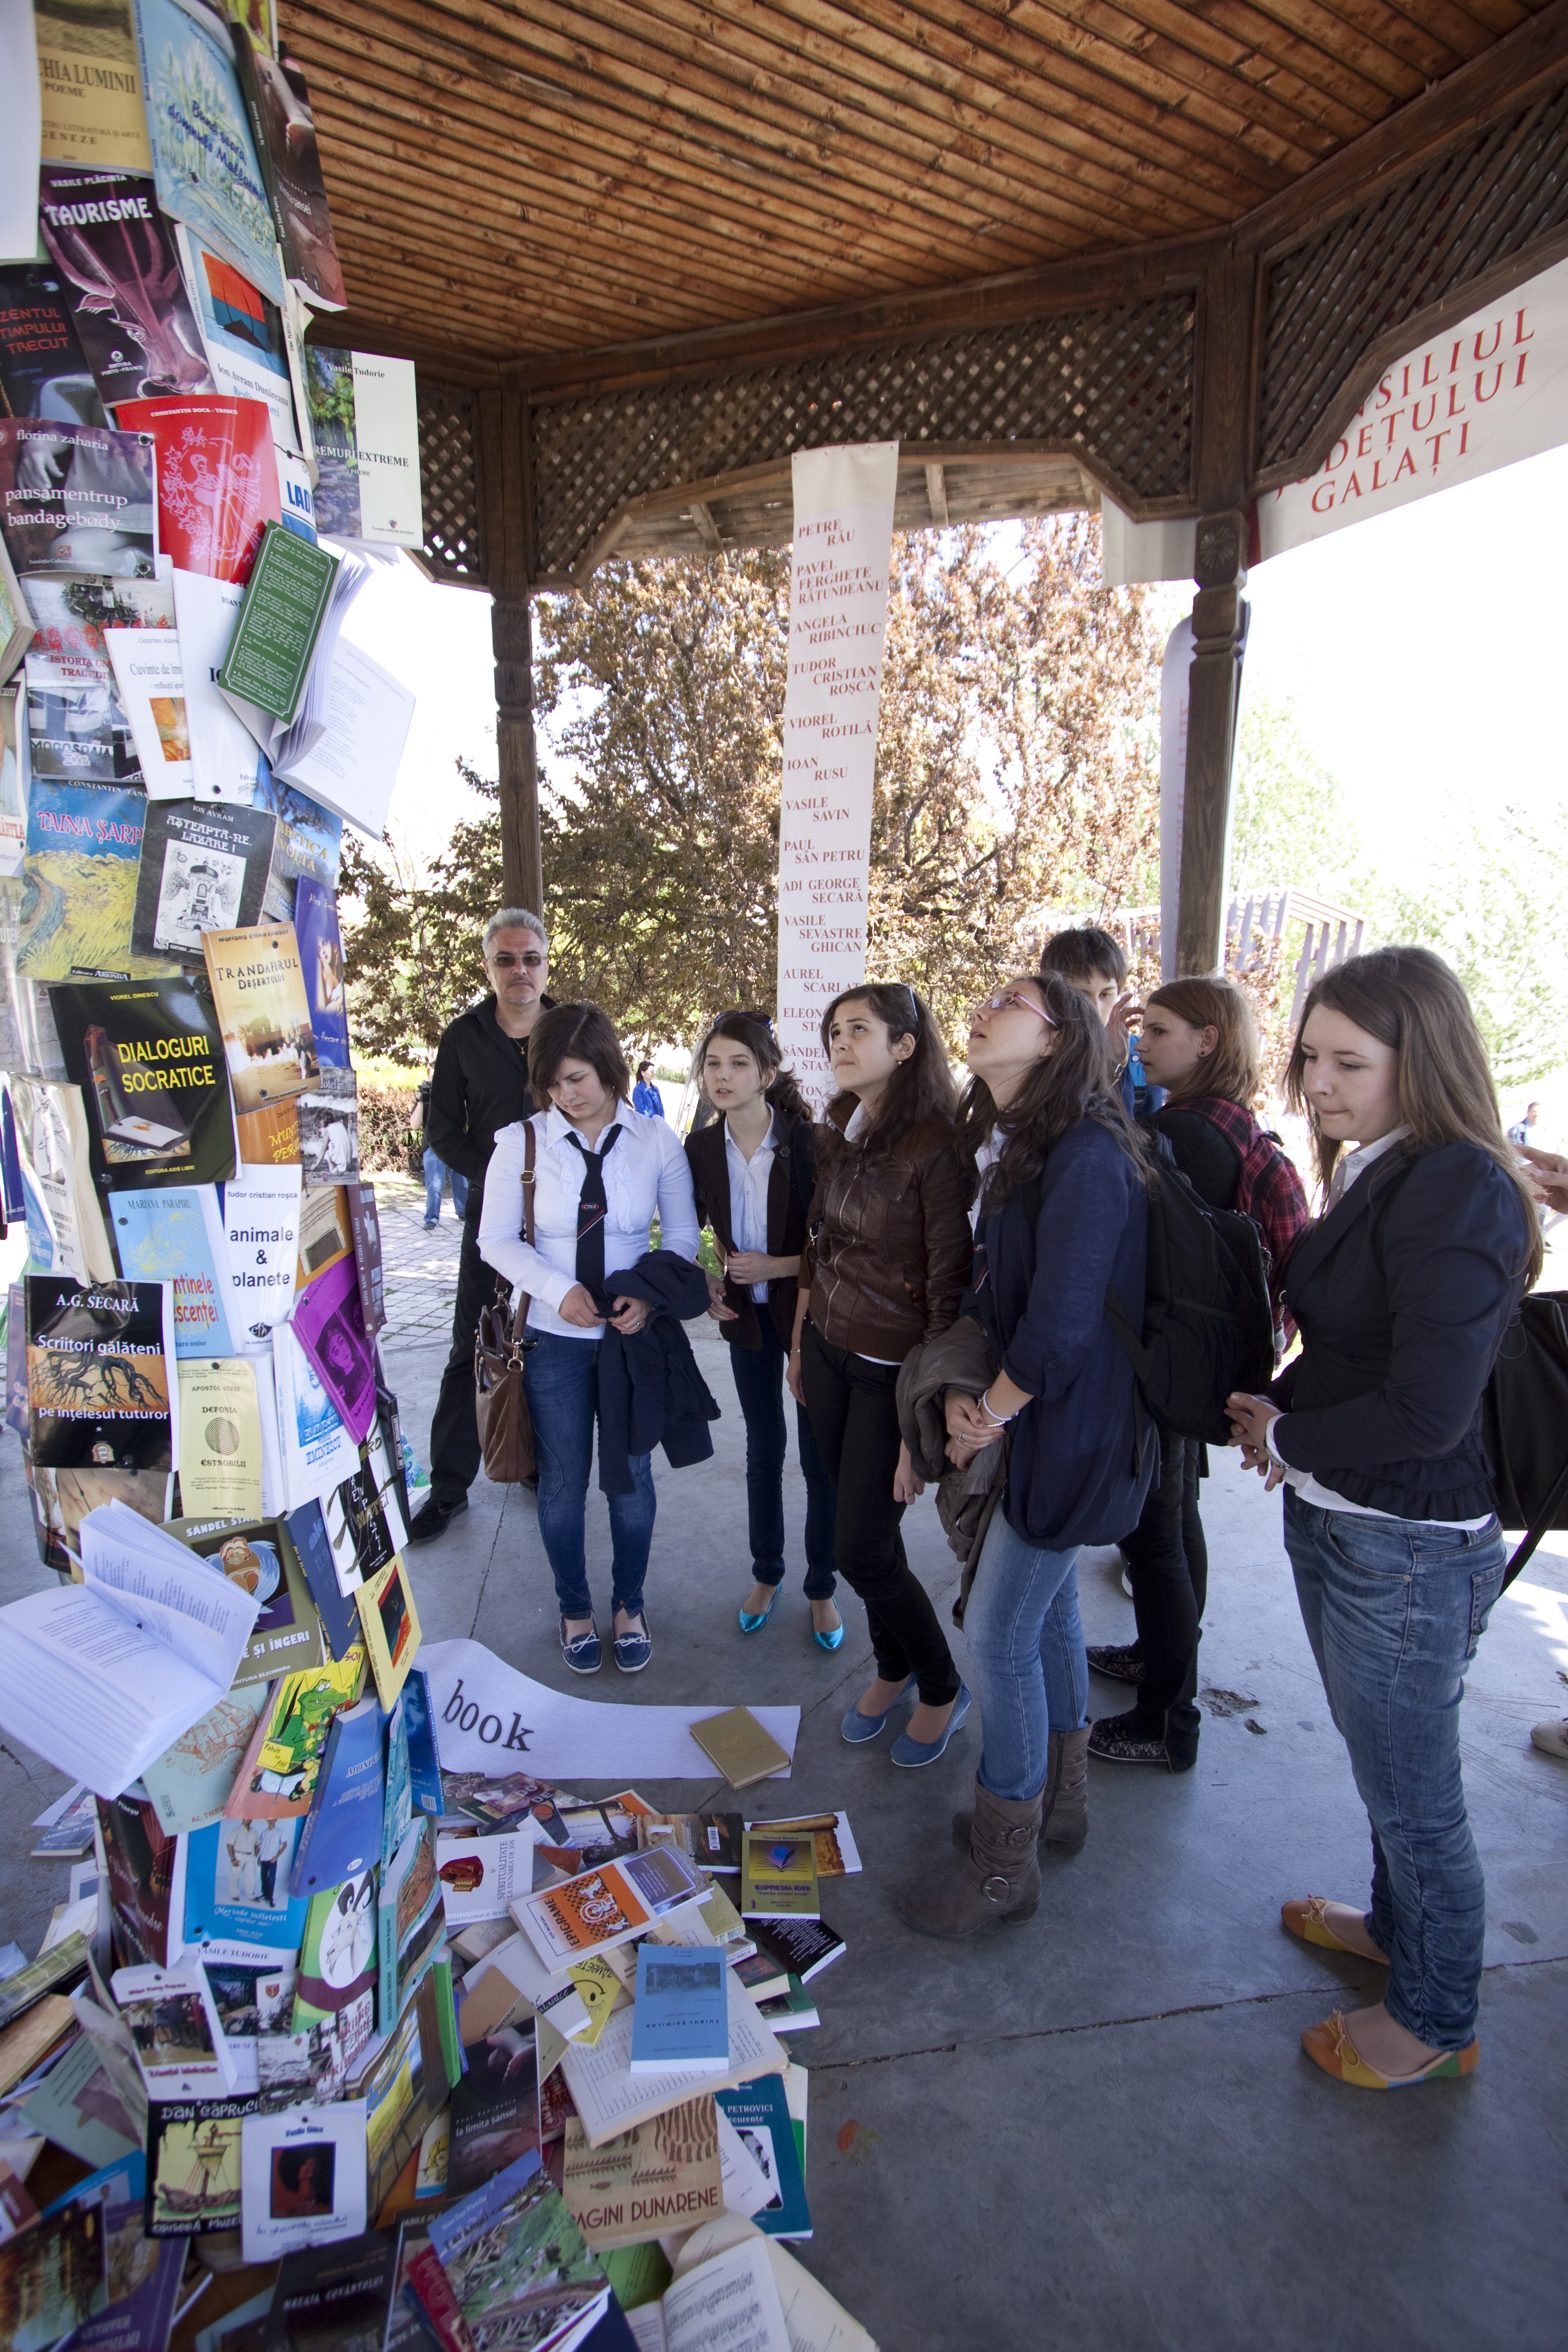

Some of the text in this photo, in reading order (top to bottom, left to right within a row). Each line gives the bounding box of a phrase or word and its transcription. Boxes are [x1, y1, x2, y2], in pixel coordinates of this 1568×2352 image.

[74, 64, 137, 94] LUMINII
[44, 81, 86, 98] POEME
[50, 178, 83, 188] VASILE
[44, 197, 153, 227] TAURISME
[6, 337, 70, 355] TRECUT
[328, 363, 385, 378] Vasile Tudorie
[217, 363, 289, 406] Ion Avram Dunăreanu
[151, 408, 192, 417] CONSTANTIN
[16, 430, 109, 451] florina zaharia
[358, 451, 409, 467] EXTREME
[1311, 419, 1471, 513] GALAȚI
[350, 468, 371, 477] POEME
[4, 488, 128, 510] pansamentrup
[8, 509, 121, 533] bandagebody
[797, 519, 843, 539] PETRE
[827, 528, 856, 547] RĂU
[796, 558, 837, 577] PAVEL
[798, 566, 873, 591] FERGHETE
[798, 579, 885, 606] RĂTUNDEANU
[793, 612, 848, 634] ANGELA
[808, 622, 882, 645] RIBINCIUC
[50, 654, 93, 667] ISTORIA
[791, 656, 837, 675] TUDOR
[130, 663, 170, 676] Cuvinte de
[813, 664, 878, 686] CRISTIAN
[829, 680, 876, 697] ROȘCA
[789, 712, 838, 730] VIOREL
[821, 718, 873, 740] ROTILĂ
[786, 756, 819, 771] IOAN
[814, 766, 848, 782] RUSU
[68, 779, 121, 793] CONSTANTIN
[785, 796, 829, 812] VASILE
[192, 805, 235, 823] ION AVRAM
[812, 808, 851, 823] SAVIN
[36, 811, 93, 837] TAINA
[182, 831, 229, 851] LAZĂRE
[783, 838, 816, 853] PAUL
[794, 848, 866, 865] SÂN PETRU
[782, 877, 860, 892] ADI GEORGE
[811, 886, 864, 904] SECARĂ
[784, 914, 827, 927] VASILE
[798, 927, 863, 940] SEVASTRE
[810, 940, 862, 953] GHICAN
[215, 957, 299, 981] TRANDAFIRUL
[783, 968, 824, 980] AUREL
[238, 975, 285, 991] DEȘERTULUI
[116, 1035, 210, 1064] DIALOGURI
[783, 1044, 828, 1059] SĂNDEL
[121, 1064, 216, 1093] SOCRATICE
[127, 1199, 192, 1210] MARIANA PARAPIRU
[230, 1226, 294, 1243] animale
[255, 1249, 268, 1265] &
[233, 1272, 291, 1287] planete
[55, 1293, 140, 1313] A.G. SECARĂ
[37, 1334, 161, 1358] Scriitori gălățeni
[39, 1407, 169, 1421] pe înțelesul tuturor
[306, 1435, 342, 1466] EMINESCU
[186, 1518, 229, 1538] SĂNDEL
[253, 1630, 311, 1660] ȘI ÎNGERI
[259, 1665, 291, 1678] ELEONORA
[441, 1679, 536, 1752] book
[191, 1814, 203, 1824] AL
[509, 1851, 515, 1859] DE
[497, 1840, 508, 1901] SPIRITUALITATE
[544, 1897, 581, 1947] EPIGRAME
[547, 1931, 556, 1940] ION
[229, 1949, 270, 1960] TUDORIE
[727, 2104, 773, 2114] PETROVICI
[455, 2107, 517, 2137] la limita șansei
[401, 2215, 426, 2227] VASILE
